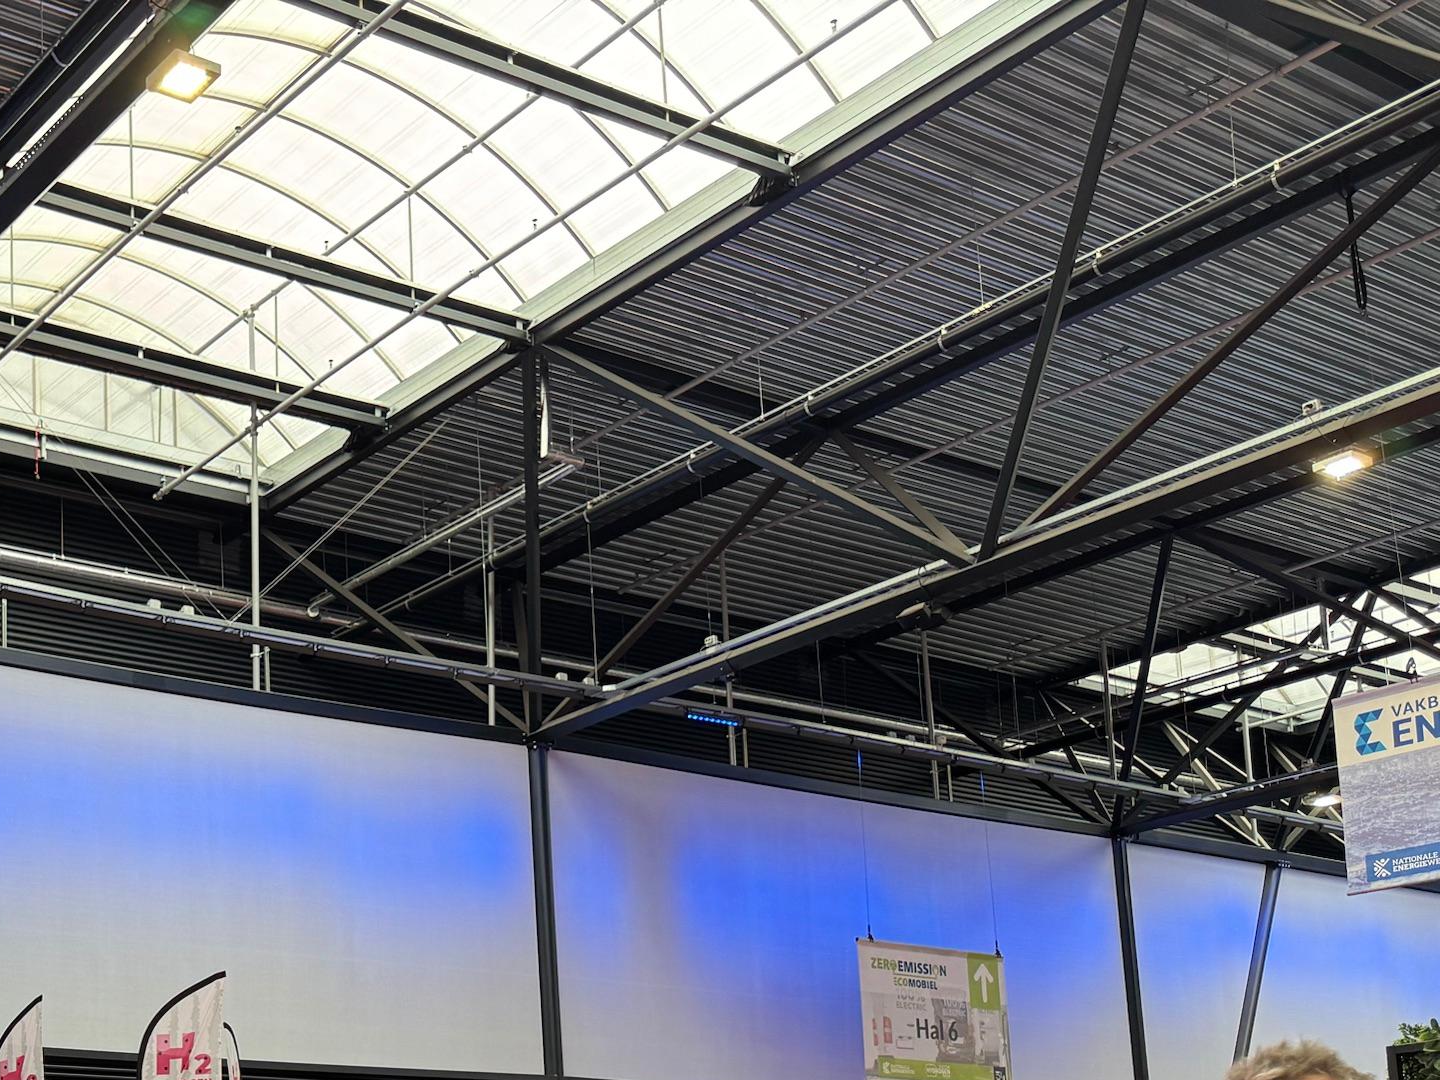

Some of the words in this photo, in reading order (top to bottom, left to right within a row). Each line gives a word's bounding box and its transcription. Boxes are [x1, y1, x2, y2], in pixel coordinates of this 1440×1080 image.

[1392, 851, 1439, 867] NATIONALE
[893, 976, 939, 991] ECOMOBIEL
[915, 1017, 944, 1041] Hal
[948, 1021, 959, 1042] 6
